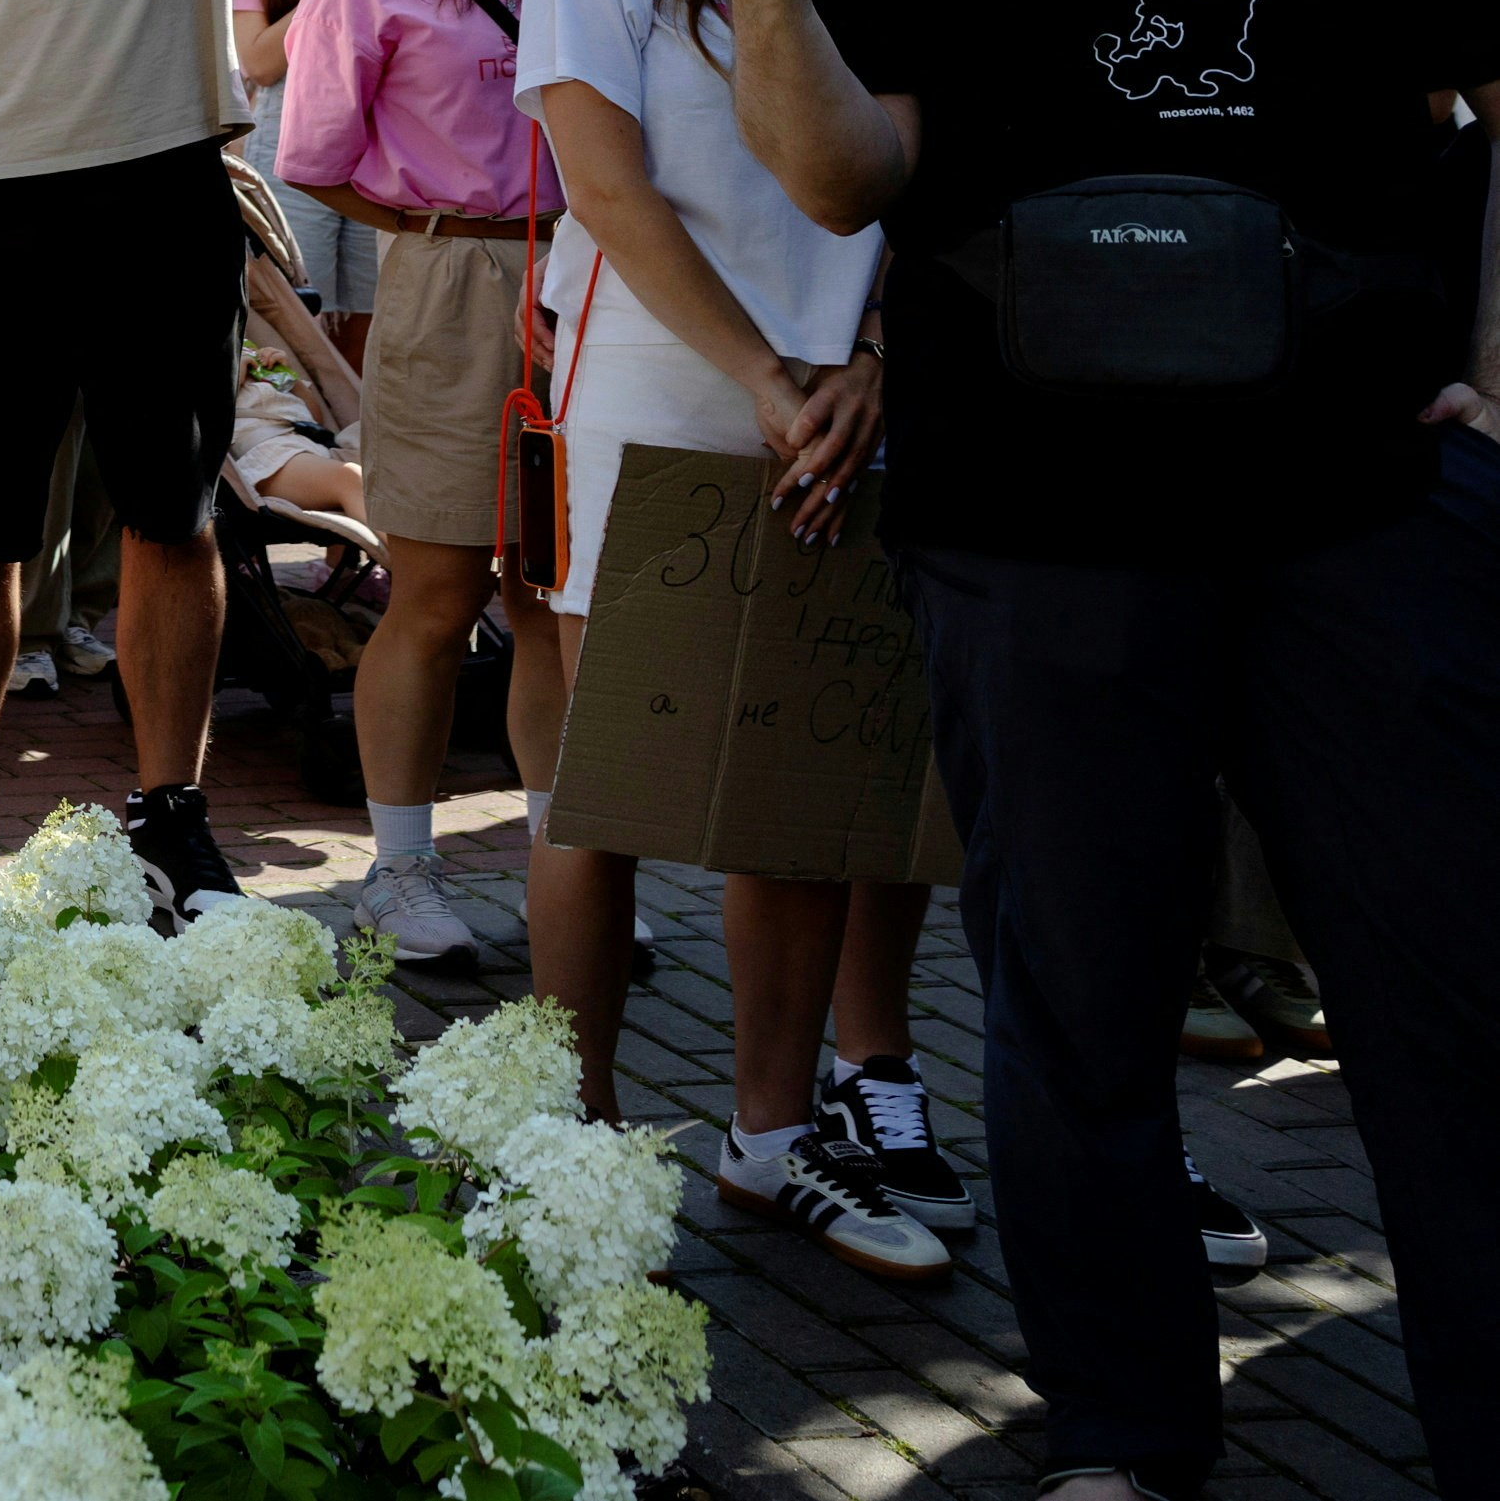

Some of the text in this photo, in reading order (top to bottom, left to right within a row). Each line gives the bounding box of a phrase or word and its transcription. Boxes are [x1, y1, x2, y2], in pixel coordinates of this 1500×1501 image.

[1158, 105, 1256, 119] moscovia, 1462
[792, 603, 925, 678] !ДРОН
[649, 693, 678, 715] а
[737, 700, 780, 728] не
